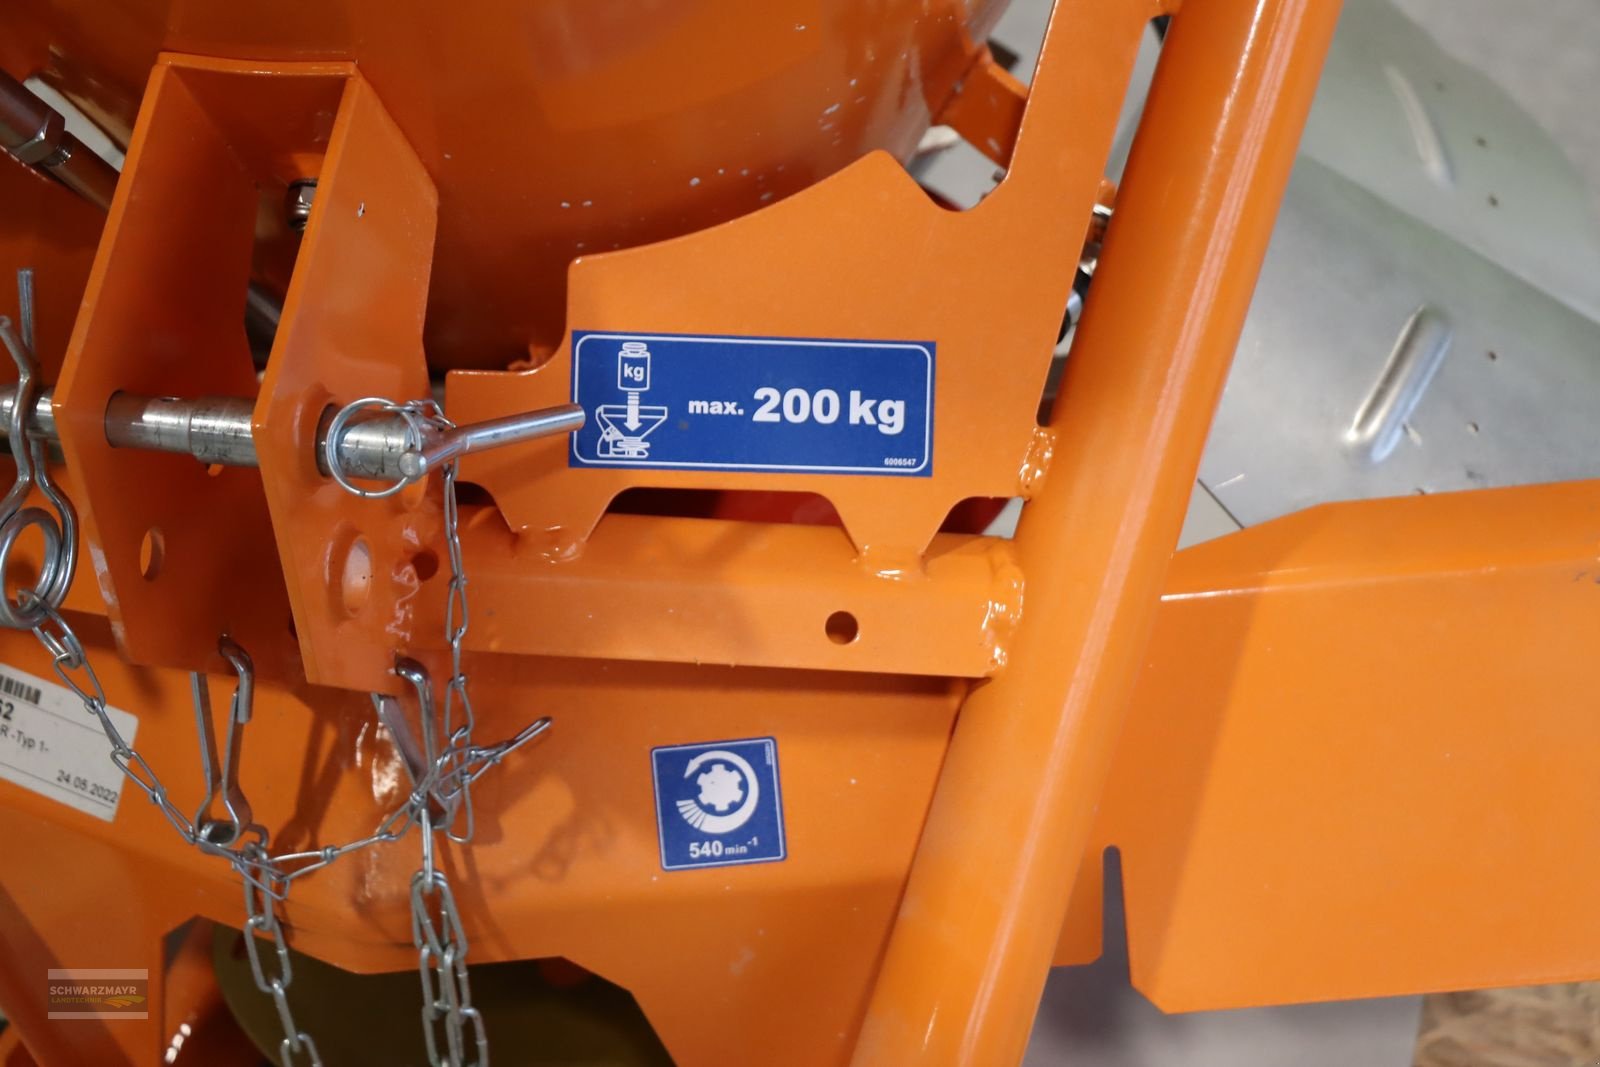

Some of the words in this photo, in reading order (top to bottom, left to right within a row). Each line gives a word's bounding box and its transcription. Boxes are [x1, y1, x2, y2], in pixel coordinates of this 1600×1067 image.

[624, 364, 644, 381] kg
[688, 399, 744, 415] max.
[752, 387, 840, 424] 200
[849, 390, 905, 435] kg
[884, 457, 917, 466] 6006547
[689, 840, 724, 858] 540
